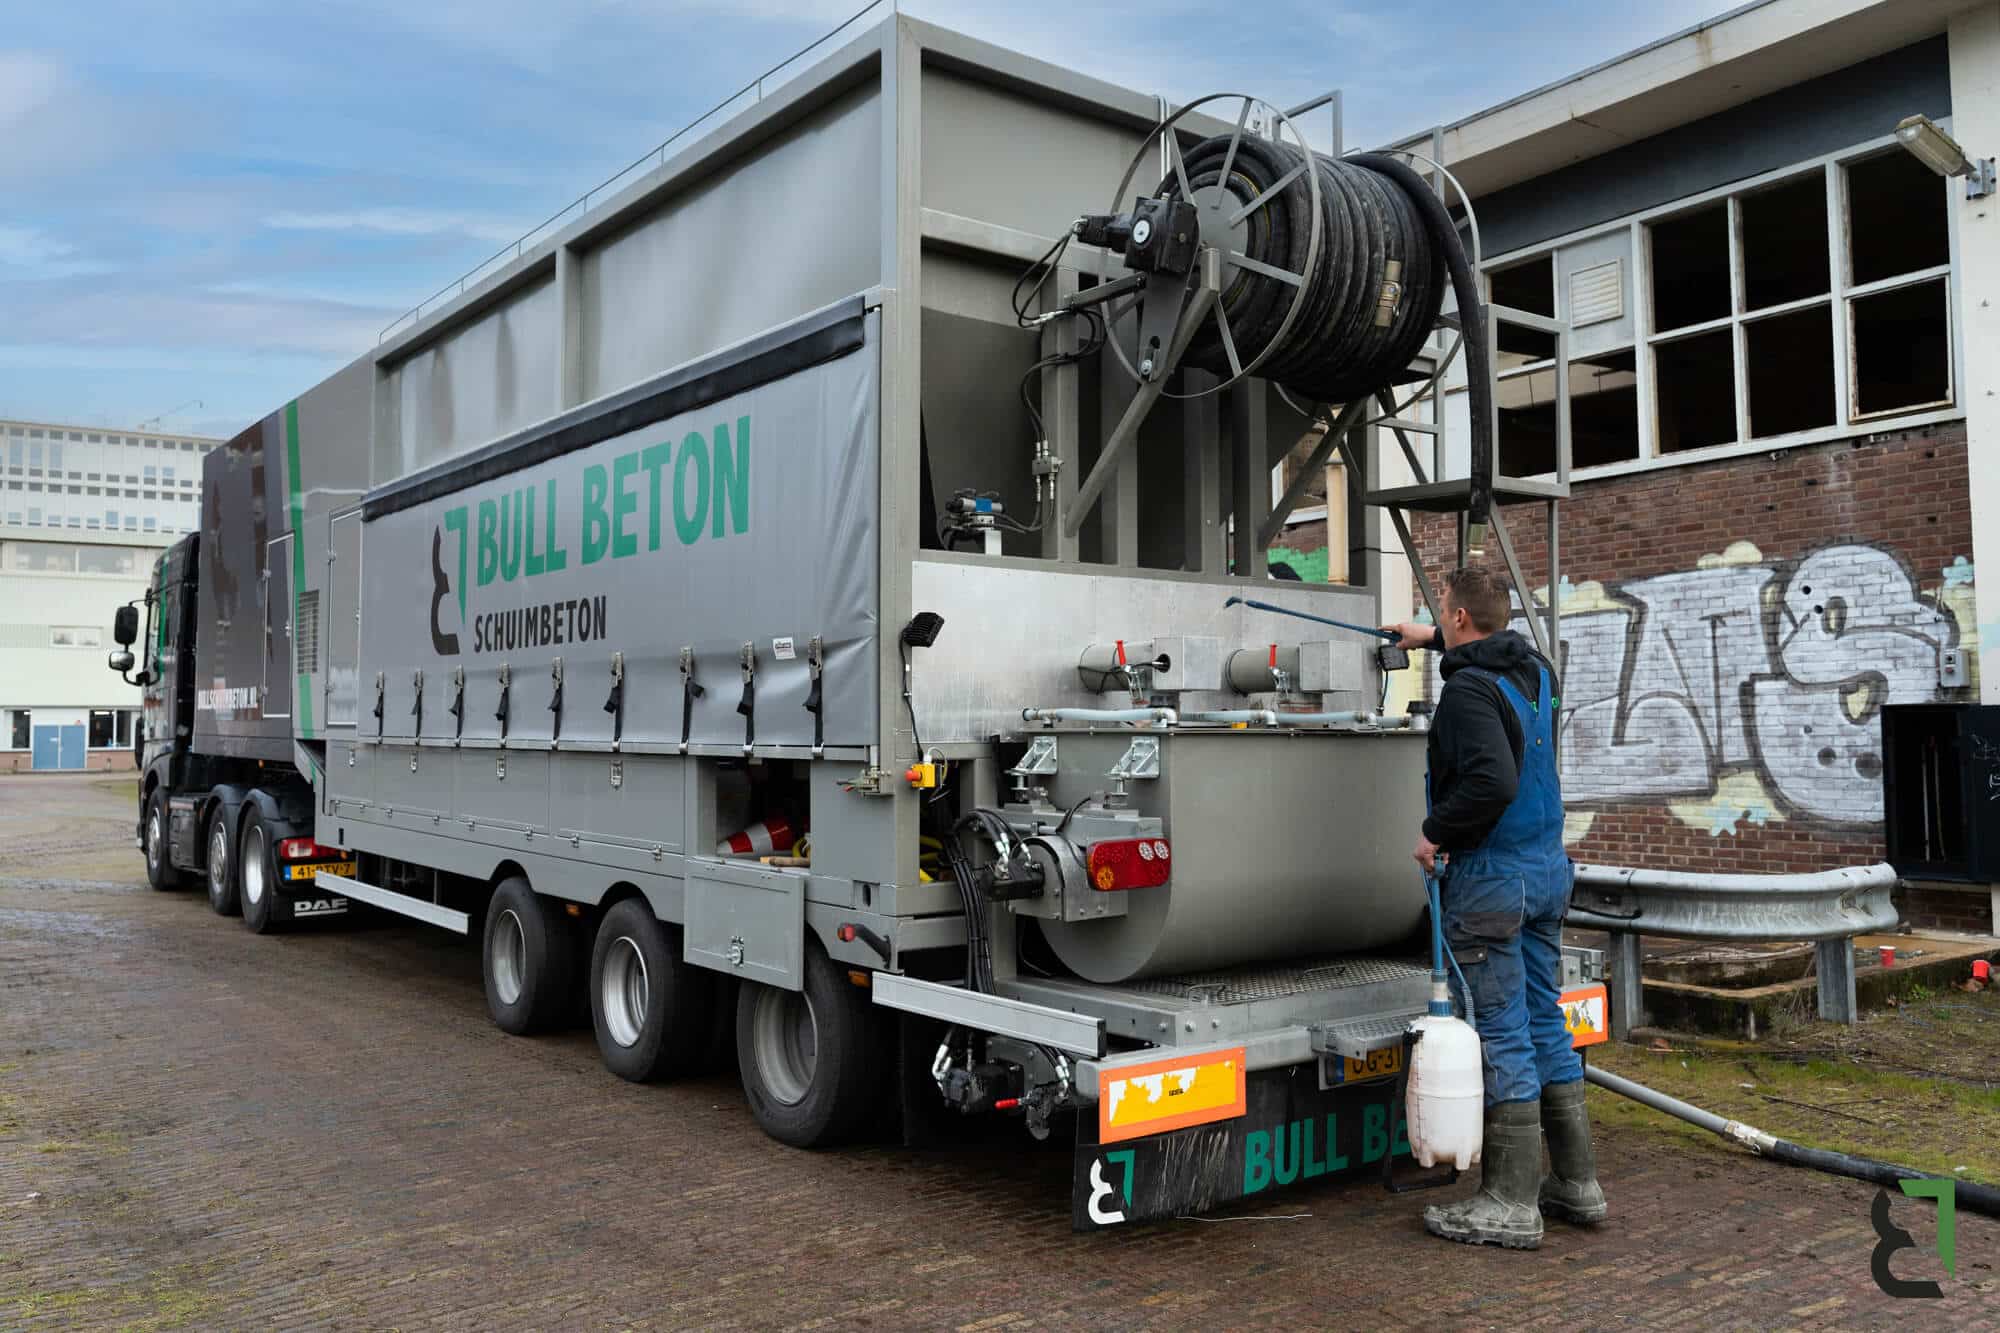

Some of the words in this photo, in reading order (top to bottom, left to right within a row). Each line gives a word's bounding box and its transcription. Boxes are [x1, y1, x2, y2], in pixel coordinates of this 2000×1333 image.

[477, 479, 567, 588] BULL
[581, 415, 751, 566] BETON
[473, 596, 607, 654] SCHUIMBETON
[294, 898, 348, 912] DAF
[1243, 1113, 1349, 1195] BULL
